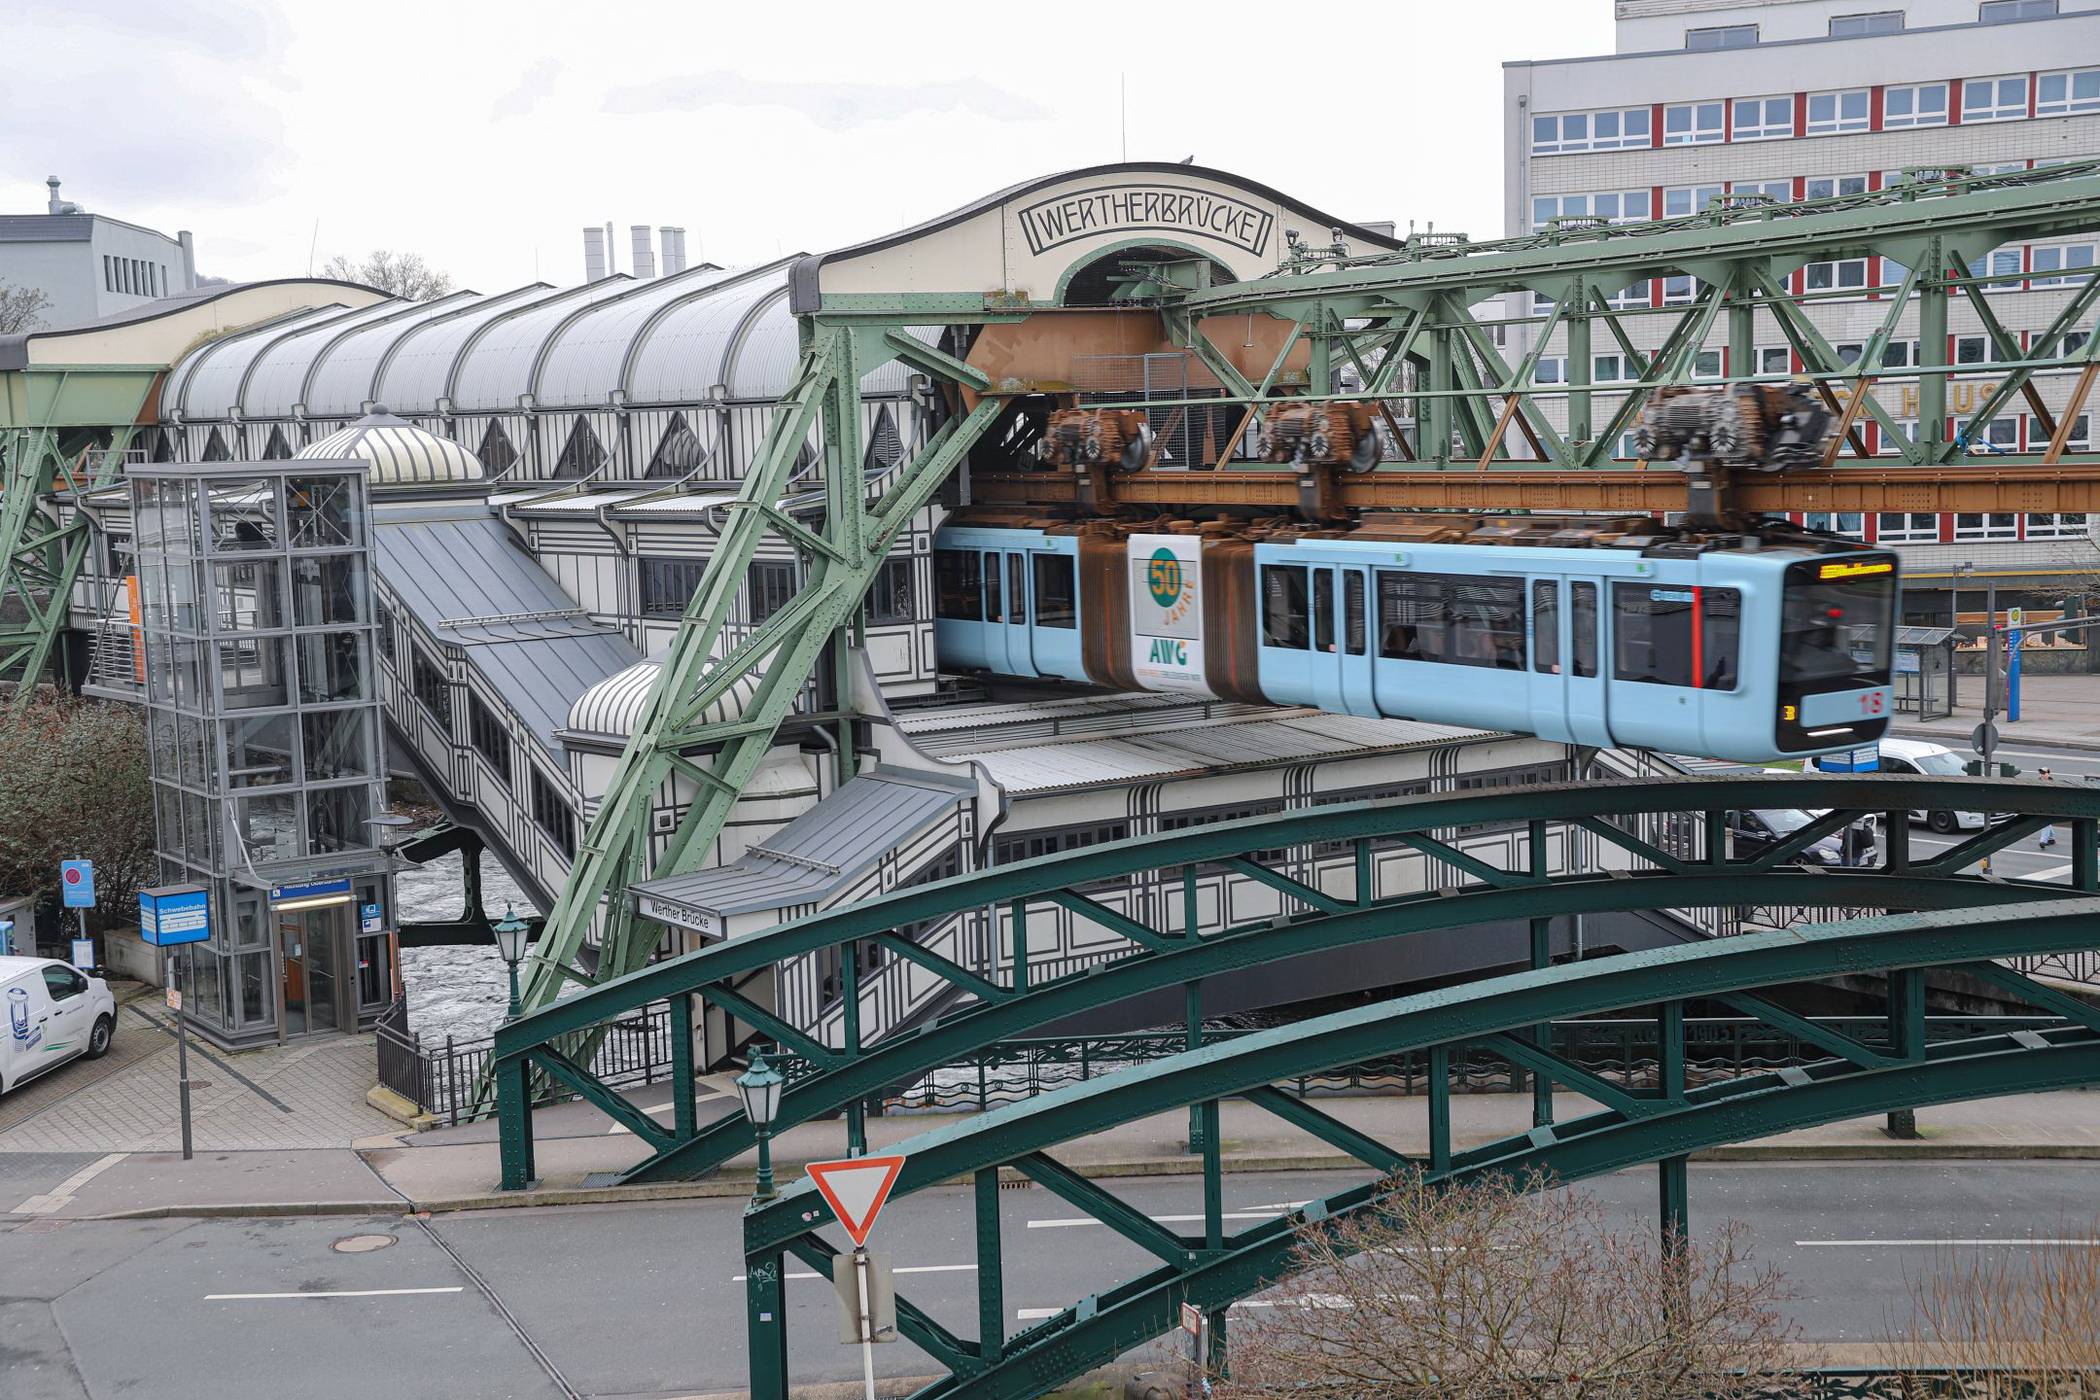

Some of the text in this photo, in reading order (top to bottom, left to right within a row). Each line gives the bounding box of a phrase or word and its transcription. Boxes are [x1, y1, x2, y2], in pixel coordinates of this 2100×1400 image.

[1037, 192, 1257, 242] WERTHERBRÜCKE
[1151, 559, 1179, 596] 50
[1149, 639, 1187, 666] AWG
[159, 903, 206, 914] Schwebebahn
[650, 900, 680, 919] Werther
